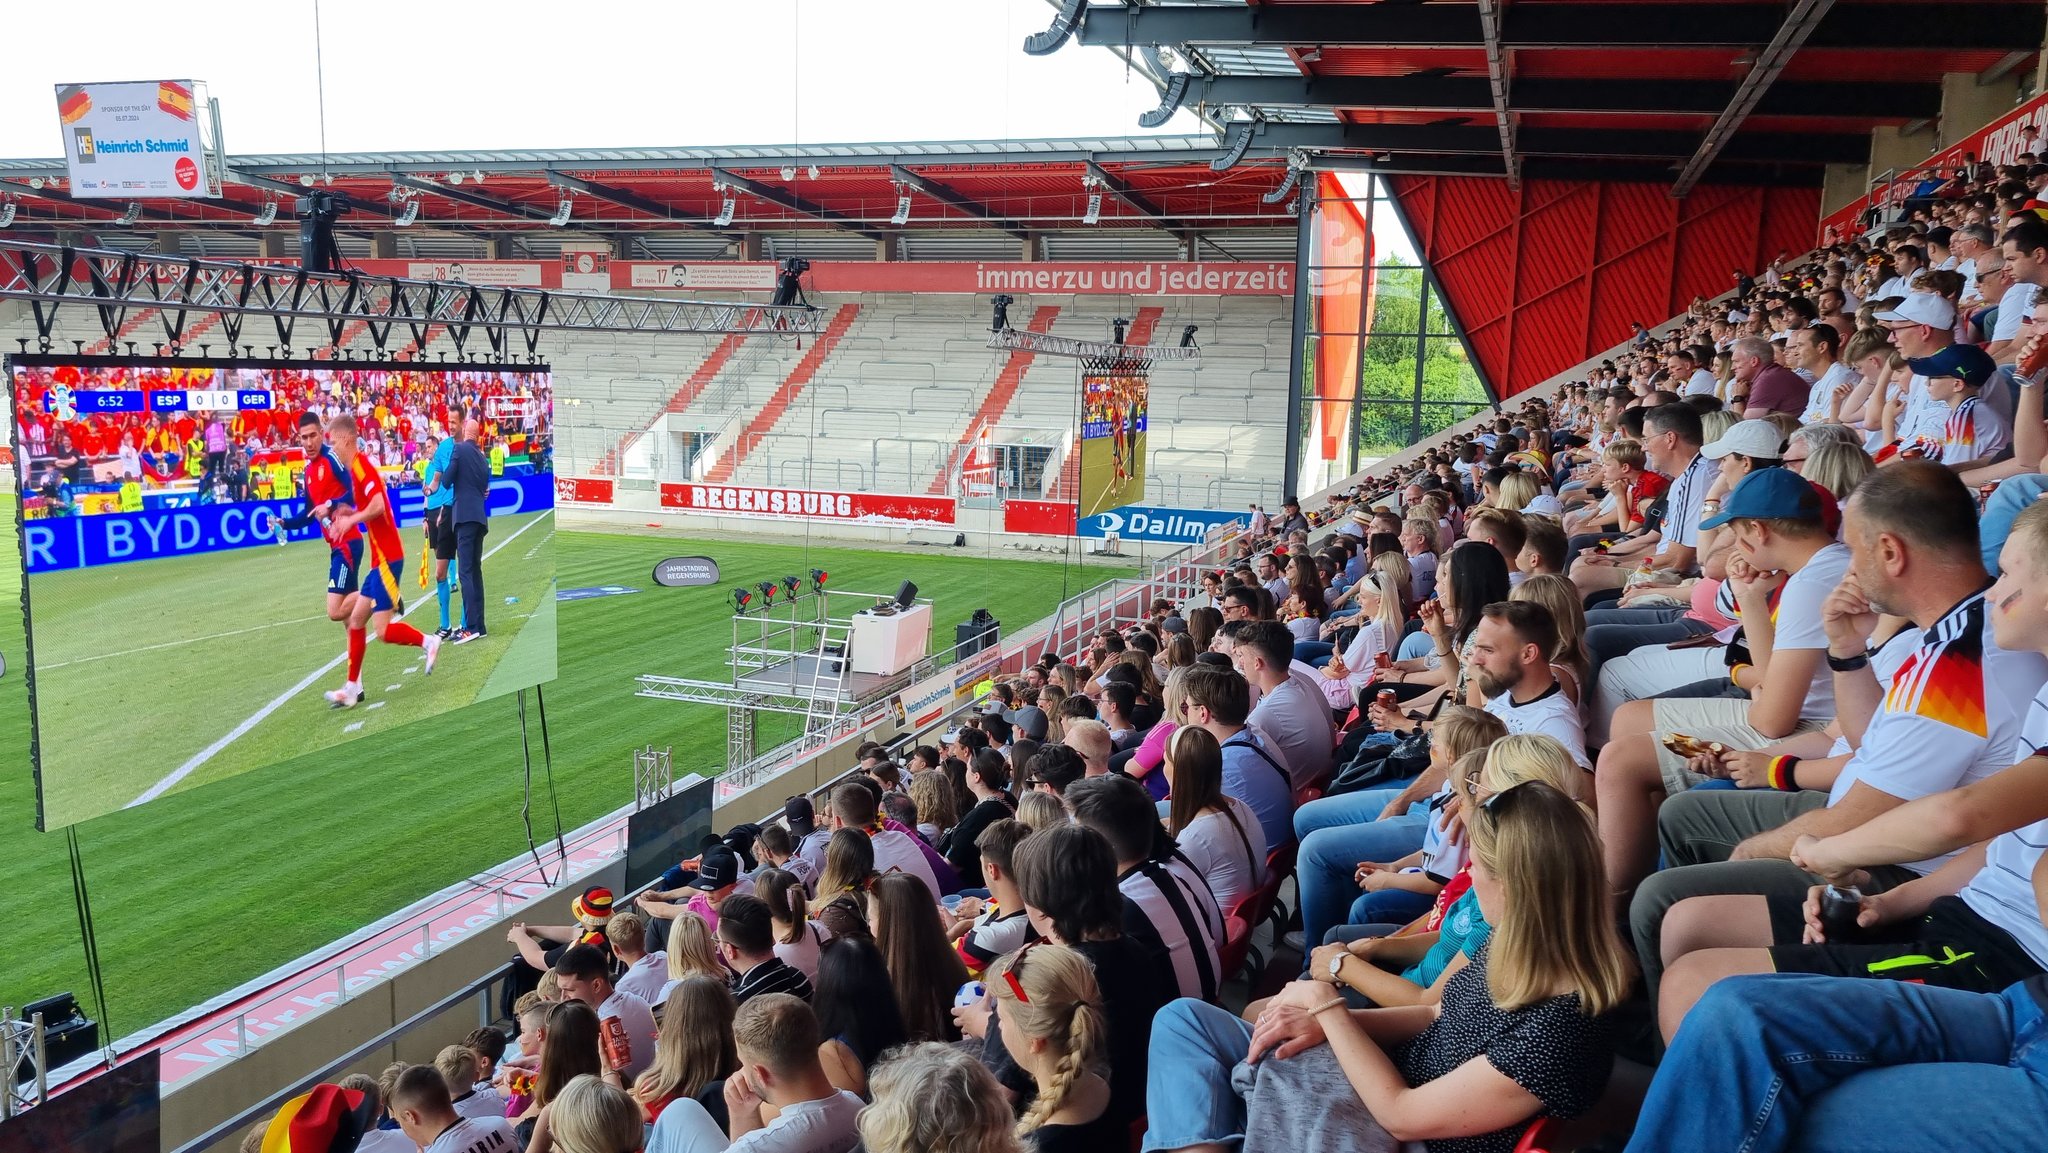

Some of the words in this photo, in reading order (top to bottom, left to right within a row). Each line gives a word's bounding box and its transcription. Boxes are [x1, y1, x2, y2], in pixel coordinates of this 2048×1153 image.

[141, 103, 152, 111] DAY
[96, 139, 143, 154] Heinrich
[145, 138, 189, 153] Schmid
[435, 267, 446, 281] 28
[657, 269, 667, 284] 17
[977, 264, 1093, 289] immerzu
[1101, 264, 1152, 289] und
[1157, 264, 1288, 296] jederzeit
[98, 396, 124, 407] 6:52
[157, 395, 181, 406] ESP
[196, 395, 204, 406] 0
[222, 394, 229, 405] 0
[243, 394, 266, 405] GER
[691, 486, 851, 515] REGENSBURG
[105, 502, 309, 559] BYD.COM
[666, 565, 709, 573] JAHNSTADION
[667, 572, 711, 580] REGENSBURG
[905, 697, 932, 715] Heinrich
[931, 684, 951, 702] Schmid
